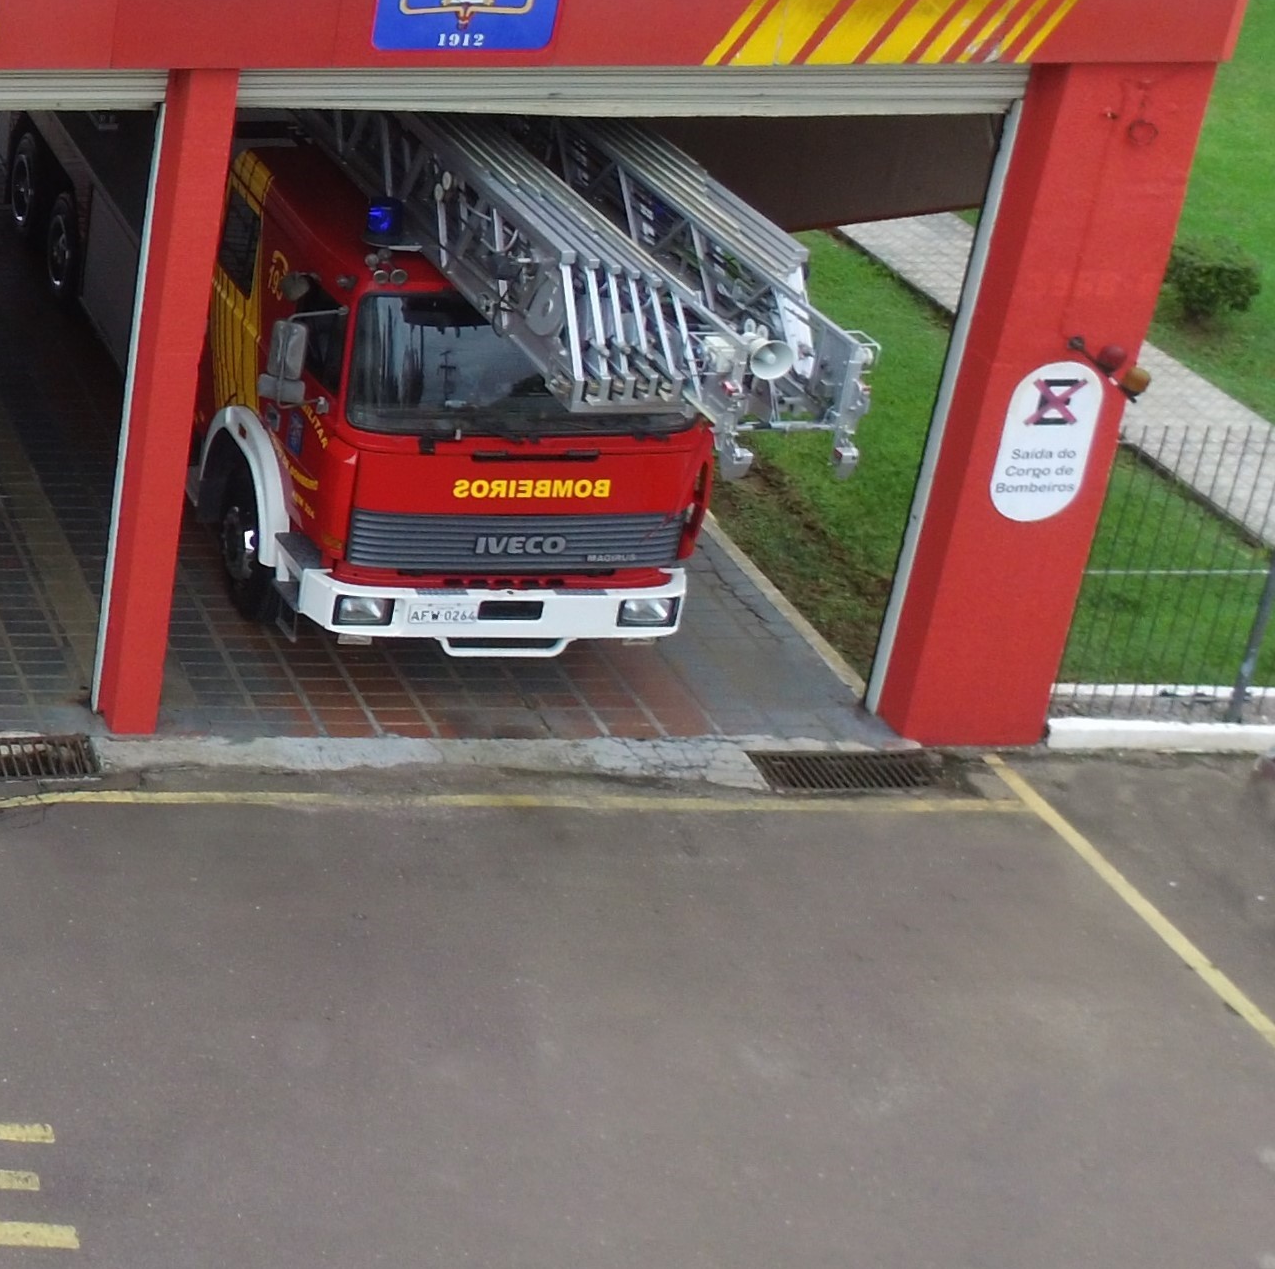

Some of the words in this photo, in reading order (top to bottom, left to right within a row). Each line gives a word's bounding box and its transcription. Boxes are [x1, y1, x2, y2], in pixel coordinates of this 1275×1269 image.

[437, 33, 485, 47] 1912
[1057, 448, 1077, 460] do
[1005, 465, 1051, 479] Corpo
[1054, 465, 1074, 477] de
[995, 482, 1075, 494] Bombeiros
[474, 535, 567, 555] IVECO
[586, 554, 636, 563] MAGIRUS
